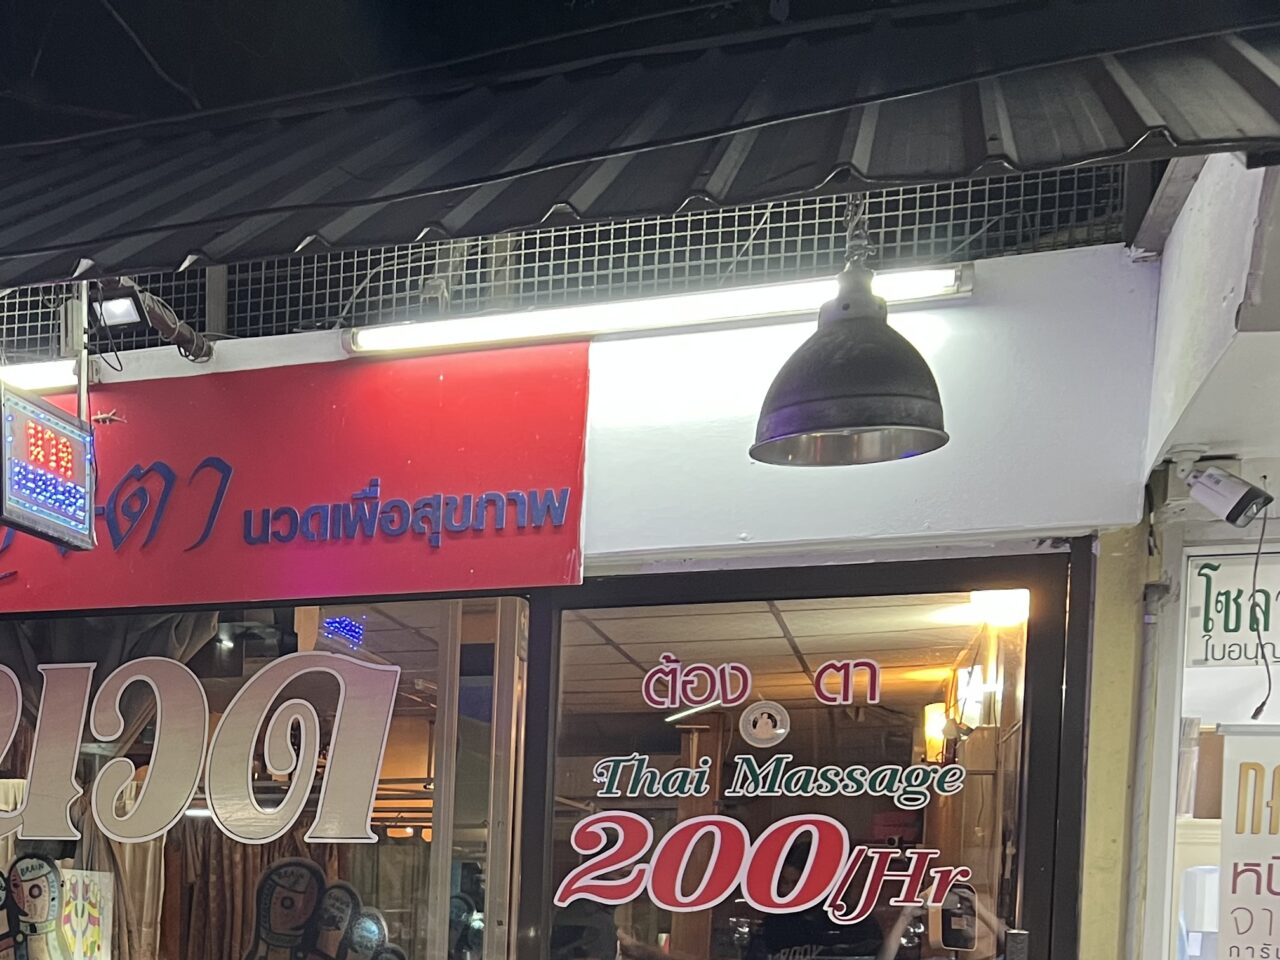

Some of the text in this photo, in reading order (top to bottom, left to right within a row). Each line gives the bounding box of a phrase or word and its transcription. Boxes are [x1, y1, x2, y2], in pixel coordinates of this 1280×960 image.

[243, 477, 571, 549] นวดเพื่อสุขภาพ
[814, 658, 880, 706] ตา
[594, 752, 966, 810] Thai Massage
[20, 863, 45, 876] BRAIN
